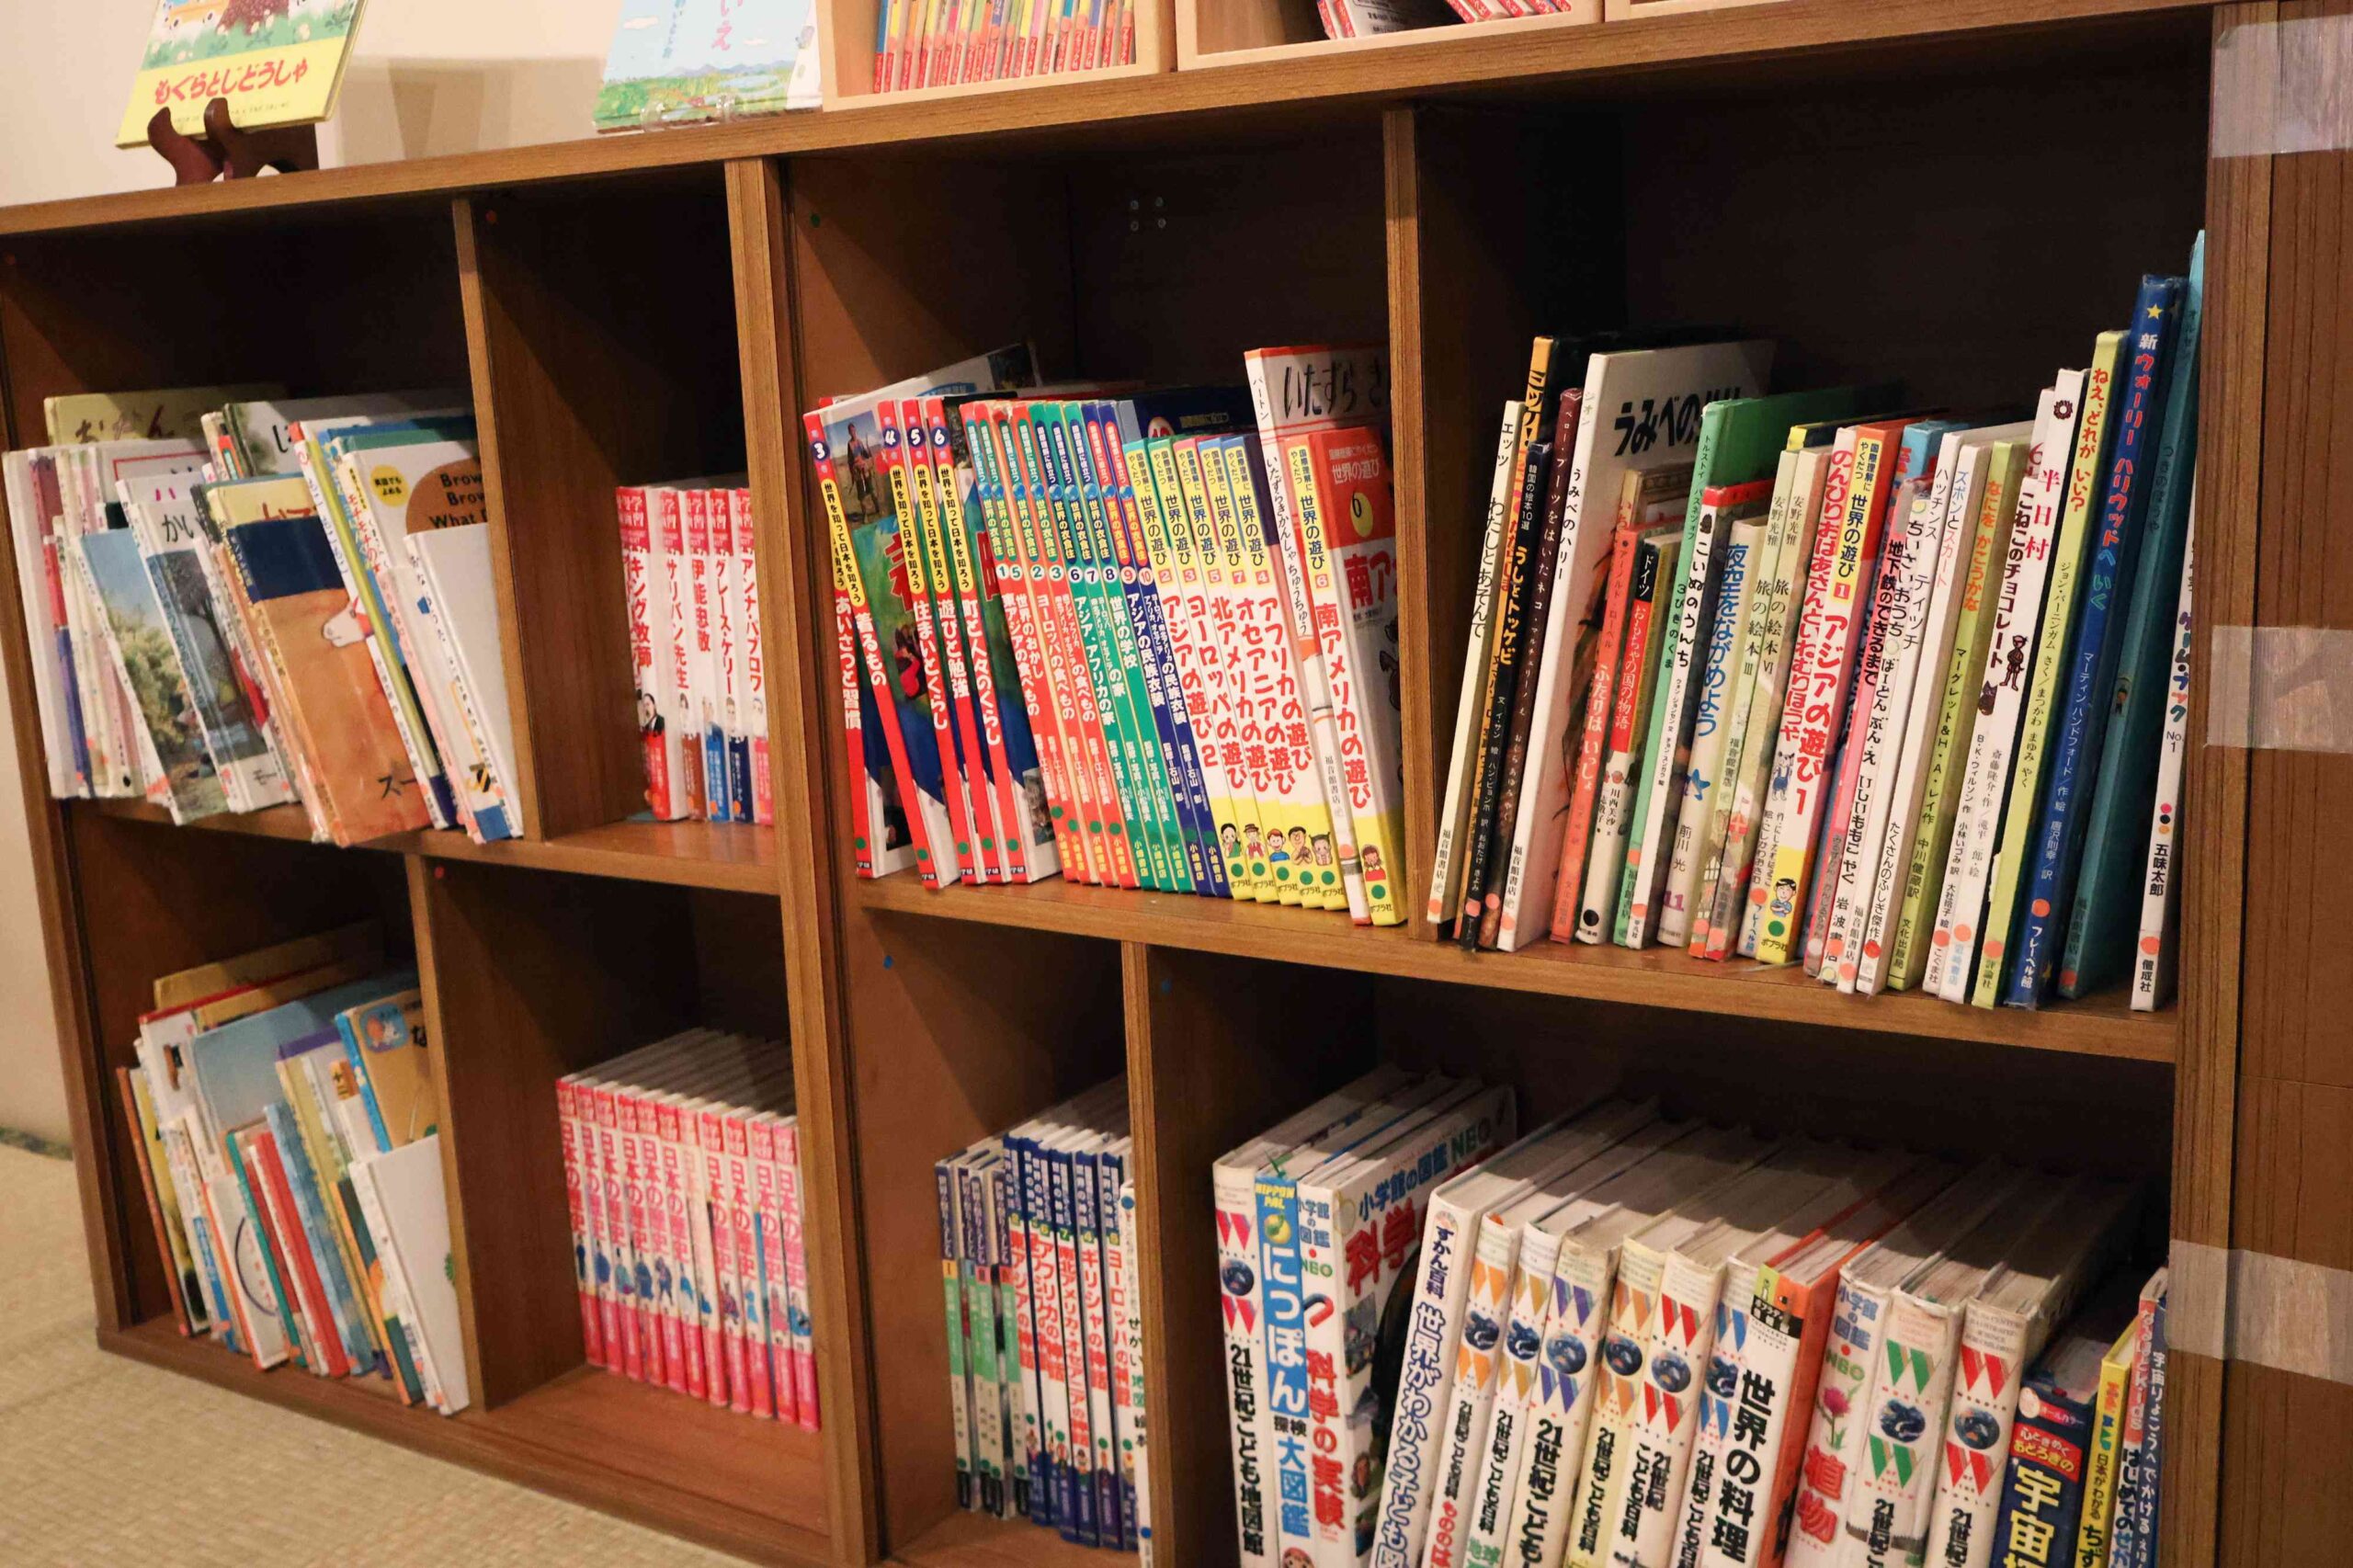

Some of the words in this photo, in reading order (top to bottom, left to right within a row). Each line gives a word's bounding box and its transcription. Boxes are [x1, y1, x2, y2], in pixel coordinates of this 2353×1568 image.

[883, 430, 896, 443] 4
[910, 430, 921, 445] 5
[934, 430, 946, 444] 6
[1497, 424, 1514, 466] エッツ
[2079, 368, 2109, 459] ねえ、どれが
[813, 446, 826, 460] 3
[1129, 455, 1142, 486] やくだつ
[1136, 453, 1152, 493] 国際理解に
[1154, 454, 1166, 484] やくだつ
[1161, 450, 1176, 491] 国際理解に
[1179, 453, 1192, 484] やくだつ
[1186, 450, 1201, 491] 国際理解に
[1203, 453, 1216, 484] やくだつ
[1211, 450, 1227, 491] 国際理解に
[1228, 453, 1240, 483] やくだつ
[1235, 449, 1251, 491] 国際理解に
[1290, 451, 1303, 484] やくだつ
[1299, 449, 1313, 491] 国際理解に
[1855, 441, 1869, 480] やくだつ
[1863, 443, 1880, 492] 国際理解に
[892, 470, 920, 589] 世界を知って日本を知ろう
[917, 470, 945, 588] 世界を知って日本を知ろう
[940, 469, 969, 588] 世界を知って日本を知ろう
[1141, 495, 1167, 564] 世界の遊び
[1165, 494, 1191, 564] 世界の遊び
[1190, 494, 1216, 565] 世界の遊び
[1215, 495, 1241, 565] 世界の遊び
[1239, 494, 1265, 566] 世界の遊び
[1301, 495, 1325, 569] 世界の遊び
[1838, 494, 1868, 578] 世界の遊び
[1925, 468, 1949, 540] ハッチンス
[1936, 471, 1970, 587] ズボンとスカート
[2025, 469, 2060, 561] 半日村
[824, 483, 861, 602] 世界を知って日本を知ろう
[999, 567, 1006, 577] 1
[1012, 568, 1020, 578] 5
[1033, 568, 1042, 577] 2
[1052, 568, 1062, 578] 3
[1071, 569, 1080, 580] 6
[1086, 571, 1096, 582] 7
[1106, 569, 1114, 579] 8
[1124, 570, 1132, 581] 9
[1141, 571, 1151, 583] 10
[1472, 497, 1505, 638] わたしとあそんで
[1638, 553, 1654, 597] ドイツ
[1887, 520, 1924, 637] ちいさいおうち
[1500, 546, 1528, 665] うしとトッケビ
[1677, 541, 1709, 668] こいぬのうんち
[1863, 540, 1904, 687] 地下鉄のできるまで
[1902, 574, 1931, 651] ティッチ
[1990, 492, 2034, 668] こねこのチョコレート
[2045, 562, 2072, 650] ジョン・バーニンガム
[666, 558, 688, 689] サリバン先生
[855, 613, 887, 686] 着るもの
[937, 599, 971, 699] 遊びと勉強
[1017, 594, 1043, 679] 世界のおかし
[1109, 597, 1137, 669] 世界の学校
[1128, 594, 1165, 708] アジアの民族衣装
[1698, 544, 1749, 736] 夜空をながめよう
[1745, 578, 1772, 657] 旅の絵本
[1763, 578, 1790, 655] 旅の絵本
[835, 597, 862, 729] あいさつと習慣
[913, 600, 948, 730] 住まいとくらし
[962, 599, 1001, 745] 町と人々のくらし
[1002, 593, 1040, 716] 東アジアの食べもの
[1037, 595, 1075, 720] ヨーロッパの食べもの
[1163, 596, 1218, 767] アジアの遊び2
[1258, 597, 1313, 770] アフリカの遊び
[1188, 595, 1247, 789] ヨーロッパの遊び
[1211, 597, 1272, 791] 北アメリカの遊び
[1236, 597, 1296, 794] オセアニアの遊び
[1315, 603, 1370, 809] 南アメリカの遊び
[1587, 664, 1610, 733] ふたりは
[1795, 615, 1848, 815] アジアの遊び1
[2023, 734, 2037, 761] まゆみ
[2166, 730, 2185, 743] No.
[2021, 767, 2033, 788] やく
[1677, 825, 1693, 852] 前川
[1845, 775, 1872, 855] いしいももこ
[1673, 857, 1687, 872] 光
[1841, 860, 1858, 884] やく
[1869, 821, 1900, 944] たくさんのふしぎ傑作
[2149, 843, 2169, 897] 五味太郎
[1663, 891, 1684, 912] 11
[2020, 926, 2042, 989] フレーベル館
[1359, 1142, 1448, 1222] 小学館の図鑑
[1346, 1198, 1416, 1297] 科学
[1262, 1243, 1309, 1416] にっぽん
[1278, 1437, 1311, 1539] 大図鑑
[1712, 1369, 1776, 1563] 世界の料理
[2002, 1464, 2063, 1568] 宇宙
